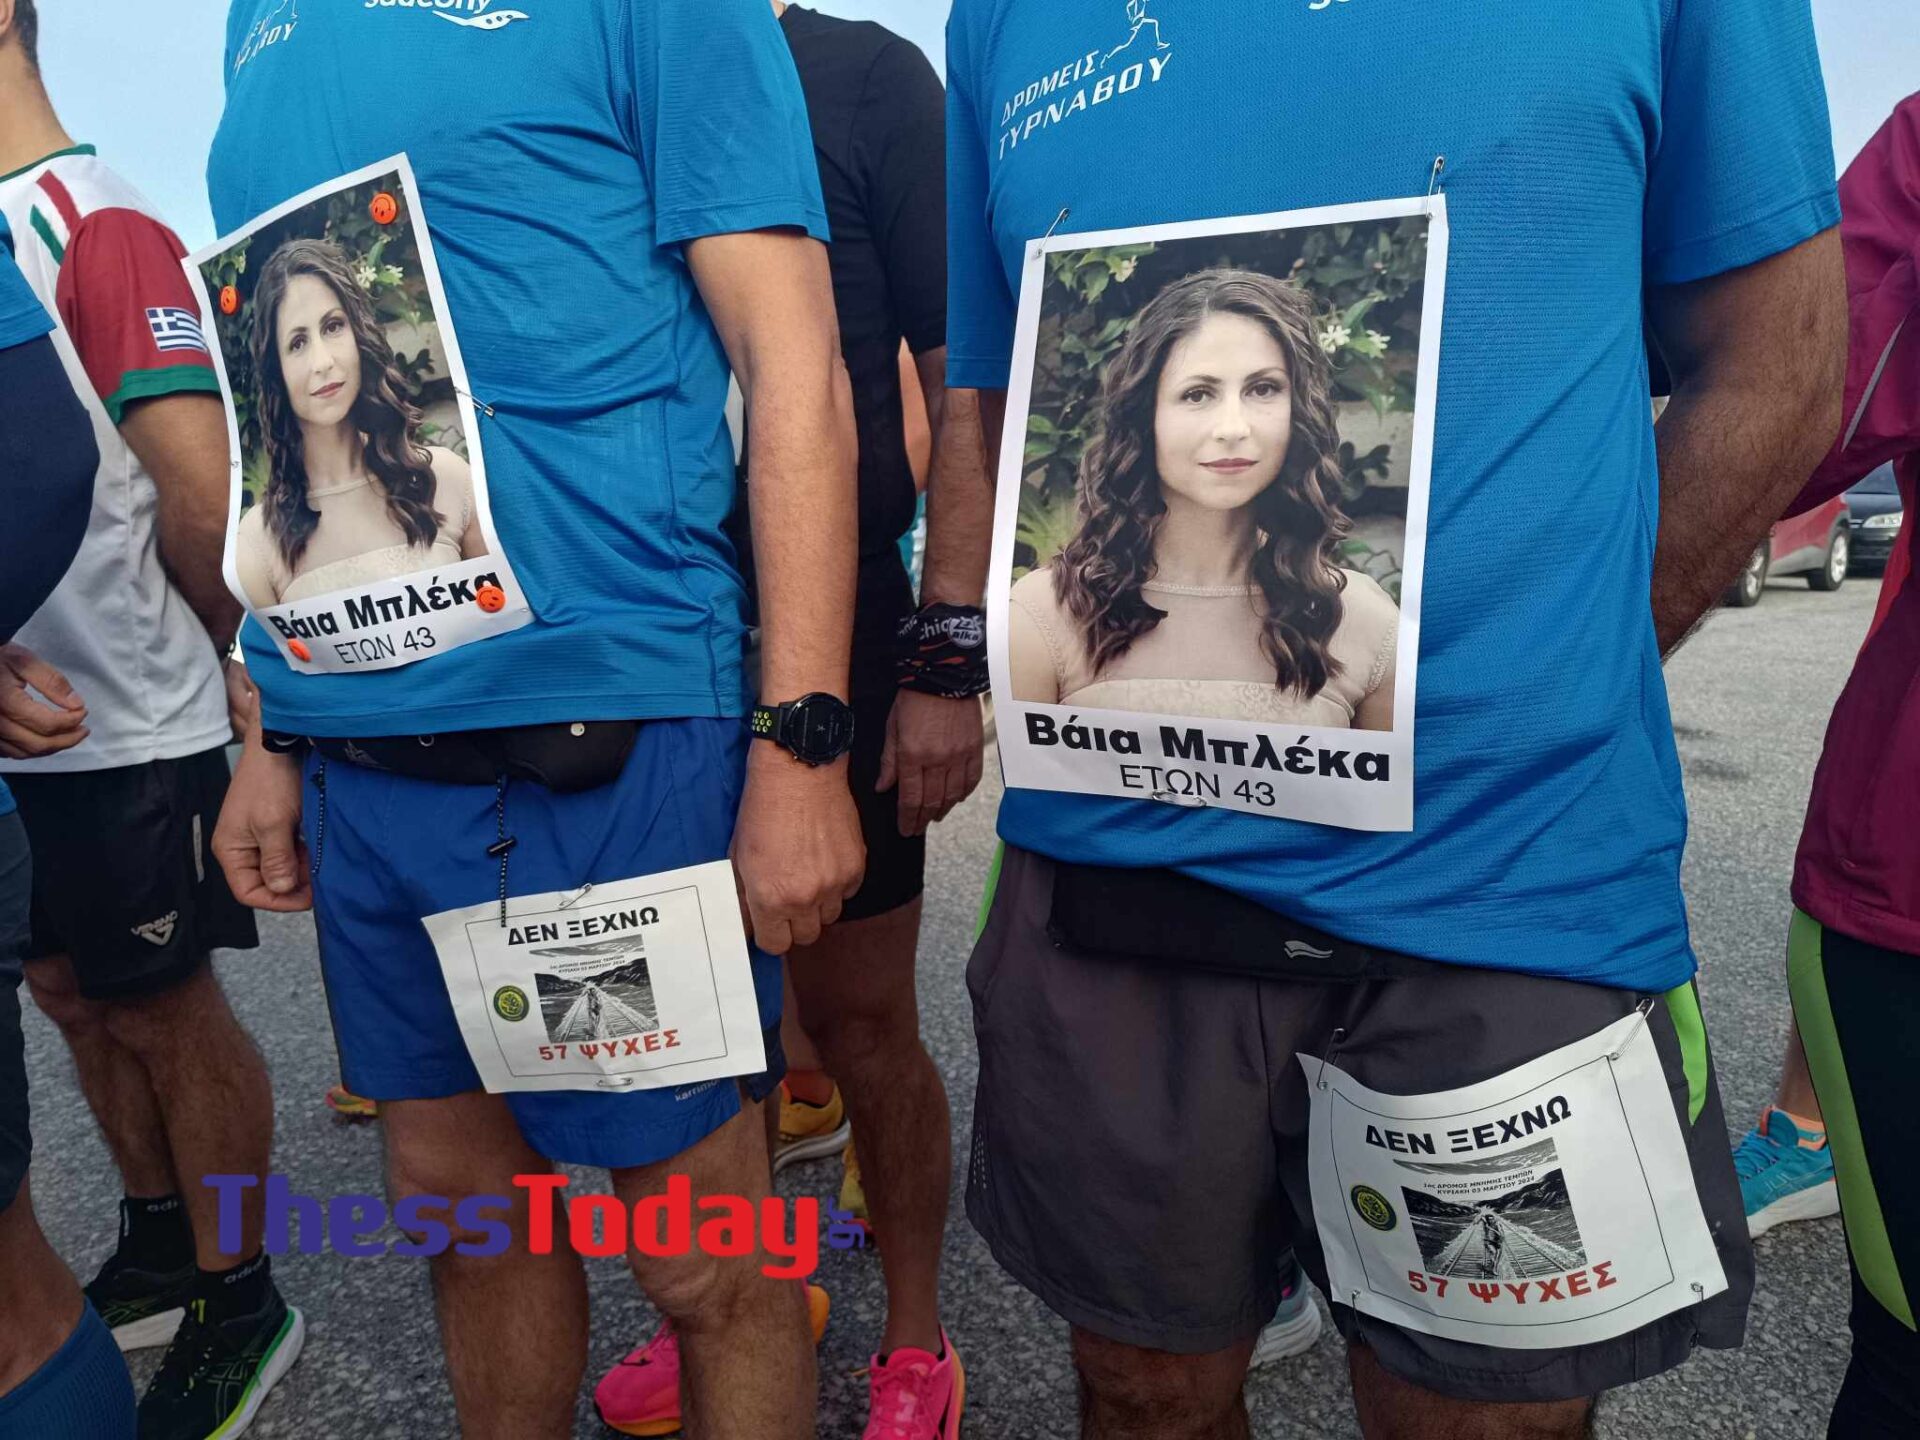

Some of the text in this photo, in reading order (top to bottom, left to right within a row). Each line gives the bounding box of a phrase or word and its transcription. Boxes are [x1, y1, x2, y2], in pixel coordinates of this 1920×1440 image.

[999, 53, 1172, 160] ΤΥΡΝΑΒΟΥ
[1000, 50, 1099, 127] ΔΡΟΜΕΙΣ
[268, 610, 340, 639] Βάια
[333, 626, 436, 664] ΕΤΩΝ 43
[1025, 712, 1391, 782] Βάια Μπλέκα
[1119, 764, 1276, 807] ΕΤΩΝ 43
[508, 906, 660, 946] ΔΕΝ ΞΕΧΝΩ
[539, 1029, 681, 1061] 57 ΨΥΧΕΣ
[1365, 1095, 1572, 1155] ΔΕΝ ΞΕΧΝΩ
[1407, 1260, 1617, 1304] 57 ΨΥΧΕΣ
